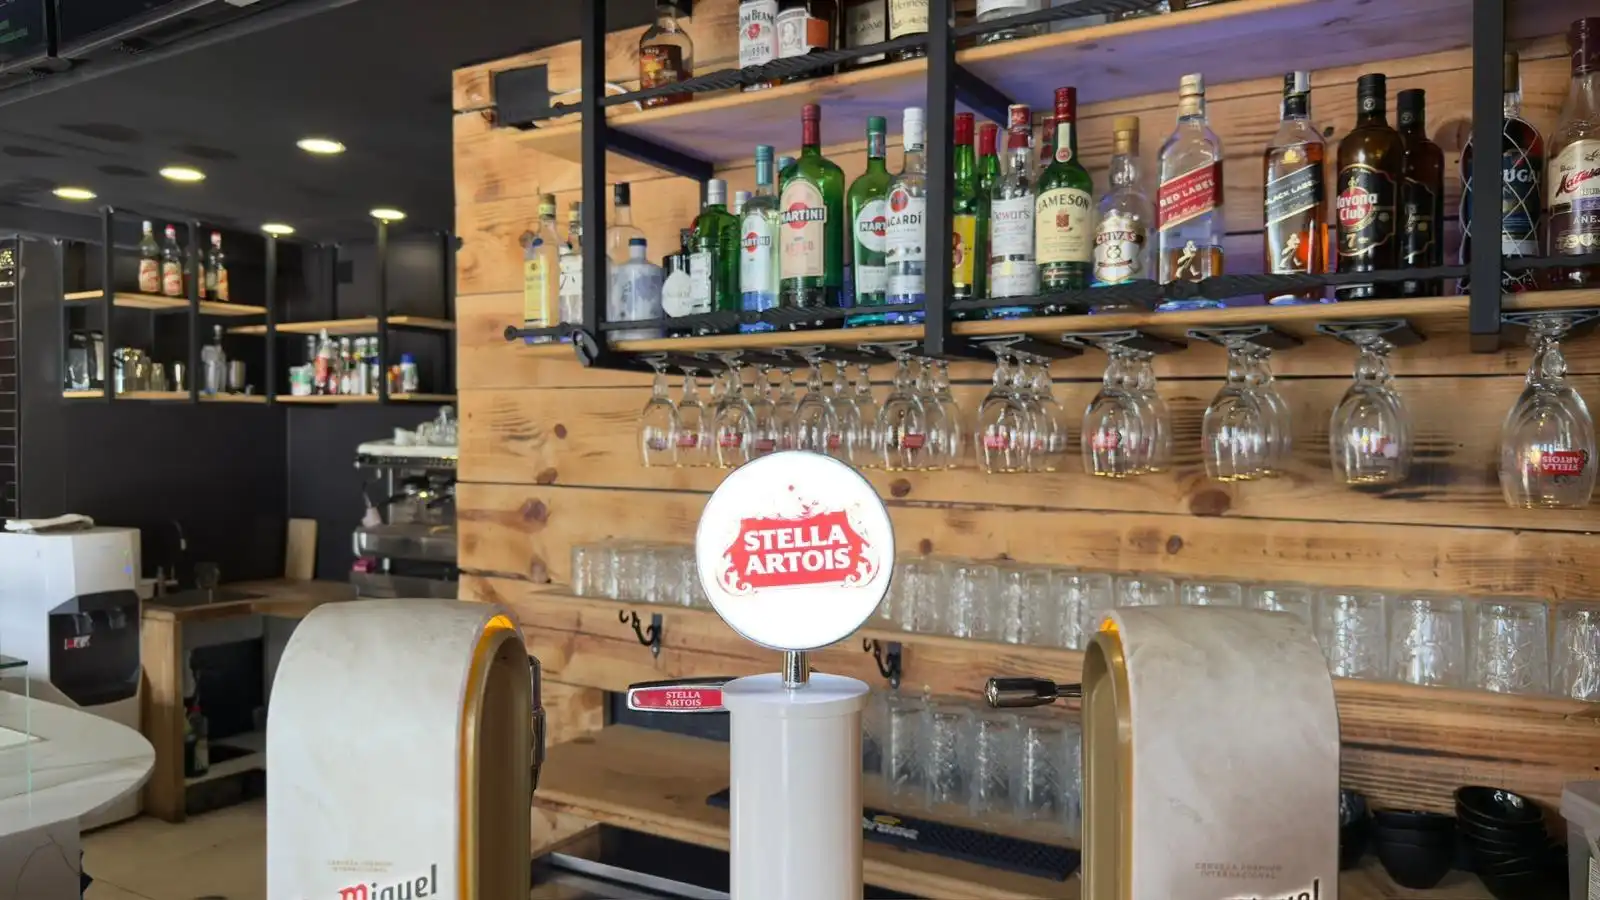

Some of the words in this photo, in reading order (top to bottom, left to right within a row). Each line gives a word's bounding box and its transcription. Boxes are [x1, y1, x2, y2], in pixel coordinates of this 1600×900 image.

[751, 9, 774, 25] BEAM
[1159, 193, 1180, 207] RED
[1181, 179, 1214, 198] LABEL
[1037, 193, 1090, 214] JAMESON
[781, 208, 824, 224] MARTINI
[1340, 205, 1366, 220] Club
[1096, 231, 1138, 245] CHIVAS
[743, 524, 849, 552] STELLA
[745, 549, 851, 576] ARTOIS
[665, 691, 701, 699] STELLA
[665, 699, 702, 707] ARTOIS
